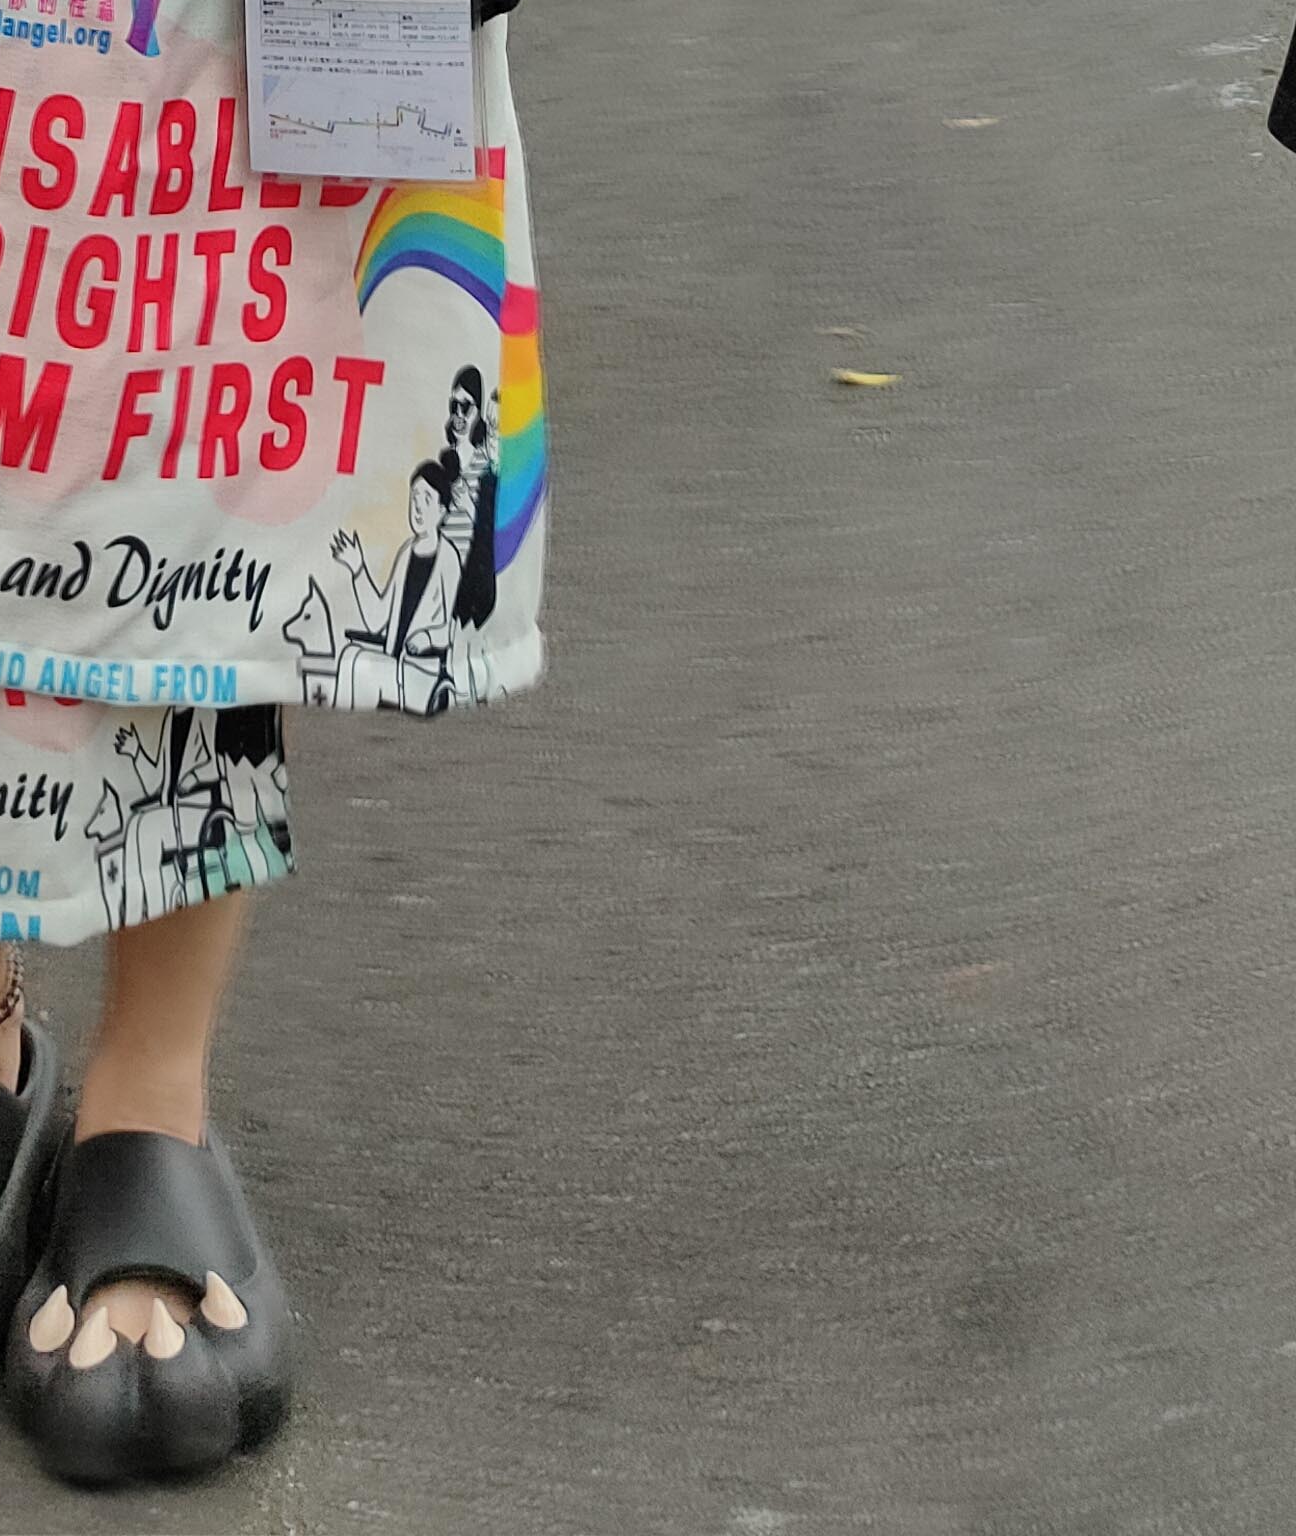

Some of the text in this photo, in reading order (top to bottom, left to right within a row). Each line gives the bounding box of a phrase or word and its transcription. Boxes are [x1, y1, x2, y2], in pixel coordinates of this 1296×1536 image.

[102, 358, 386, 482] FIRST
[0, 540, 92, 602] and
[105, 533, 272, 633] Dignity
[36, 660, 146, 703] ANGEL
[154, 664, 239, 704] FROM
